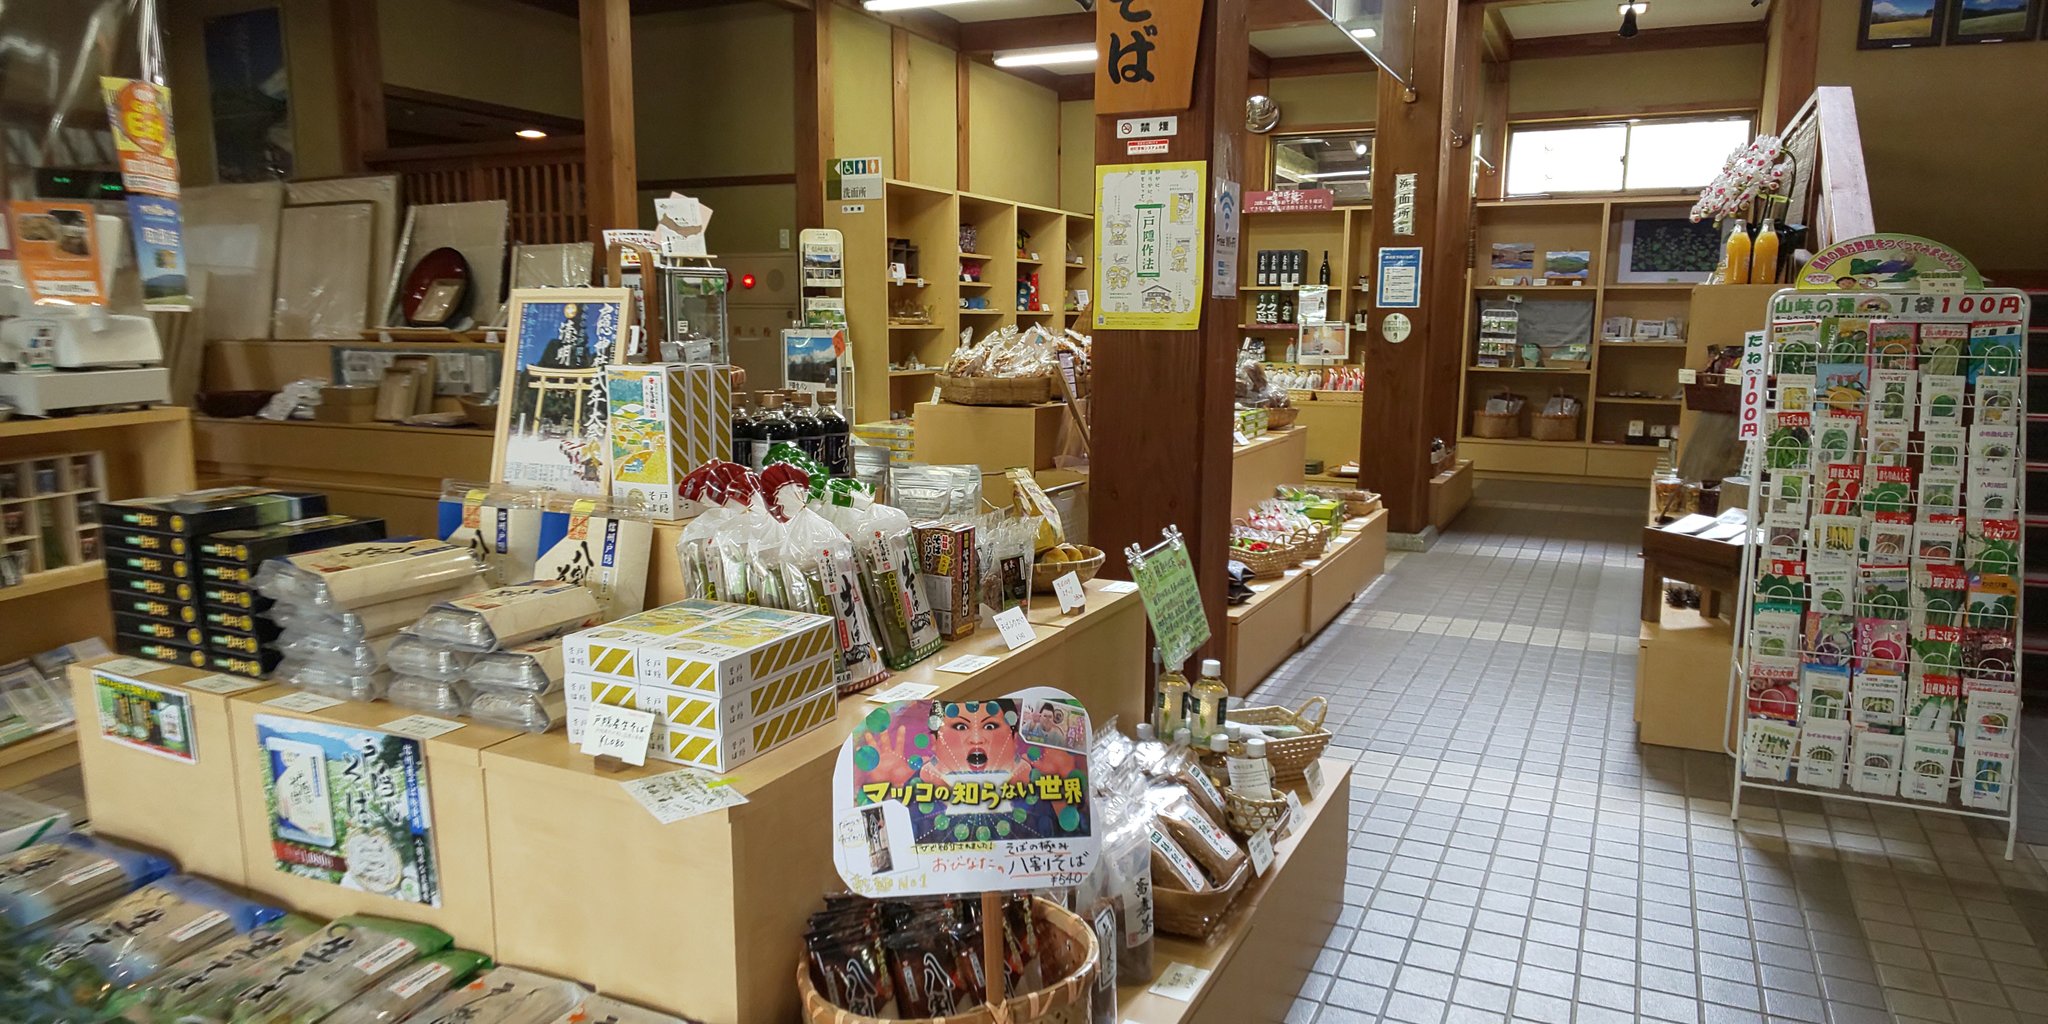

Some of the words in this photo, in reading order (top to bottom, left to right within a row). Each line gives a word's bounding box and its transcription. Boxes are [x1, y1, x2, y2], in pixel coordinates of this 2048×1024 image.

[1140, 121, 1169, 133] 禁煙
[843, 186, 867, 199] 洗面所
[1398, 178, 1411, 219] 洗面所
[1141, 216, 1155, 271] 戸隠作法
[1740, 376, 1758, 437] 100円
[601, 520, 619, 567] 信州戸隠
[1933, 575, 1965, 589] 野沢菜
[863, 777, 1083, 810] マツコの知らない世界
[1009, 851, 1089, 876] 八割そば
[1050, 873, 1083, 886] ¥540
